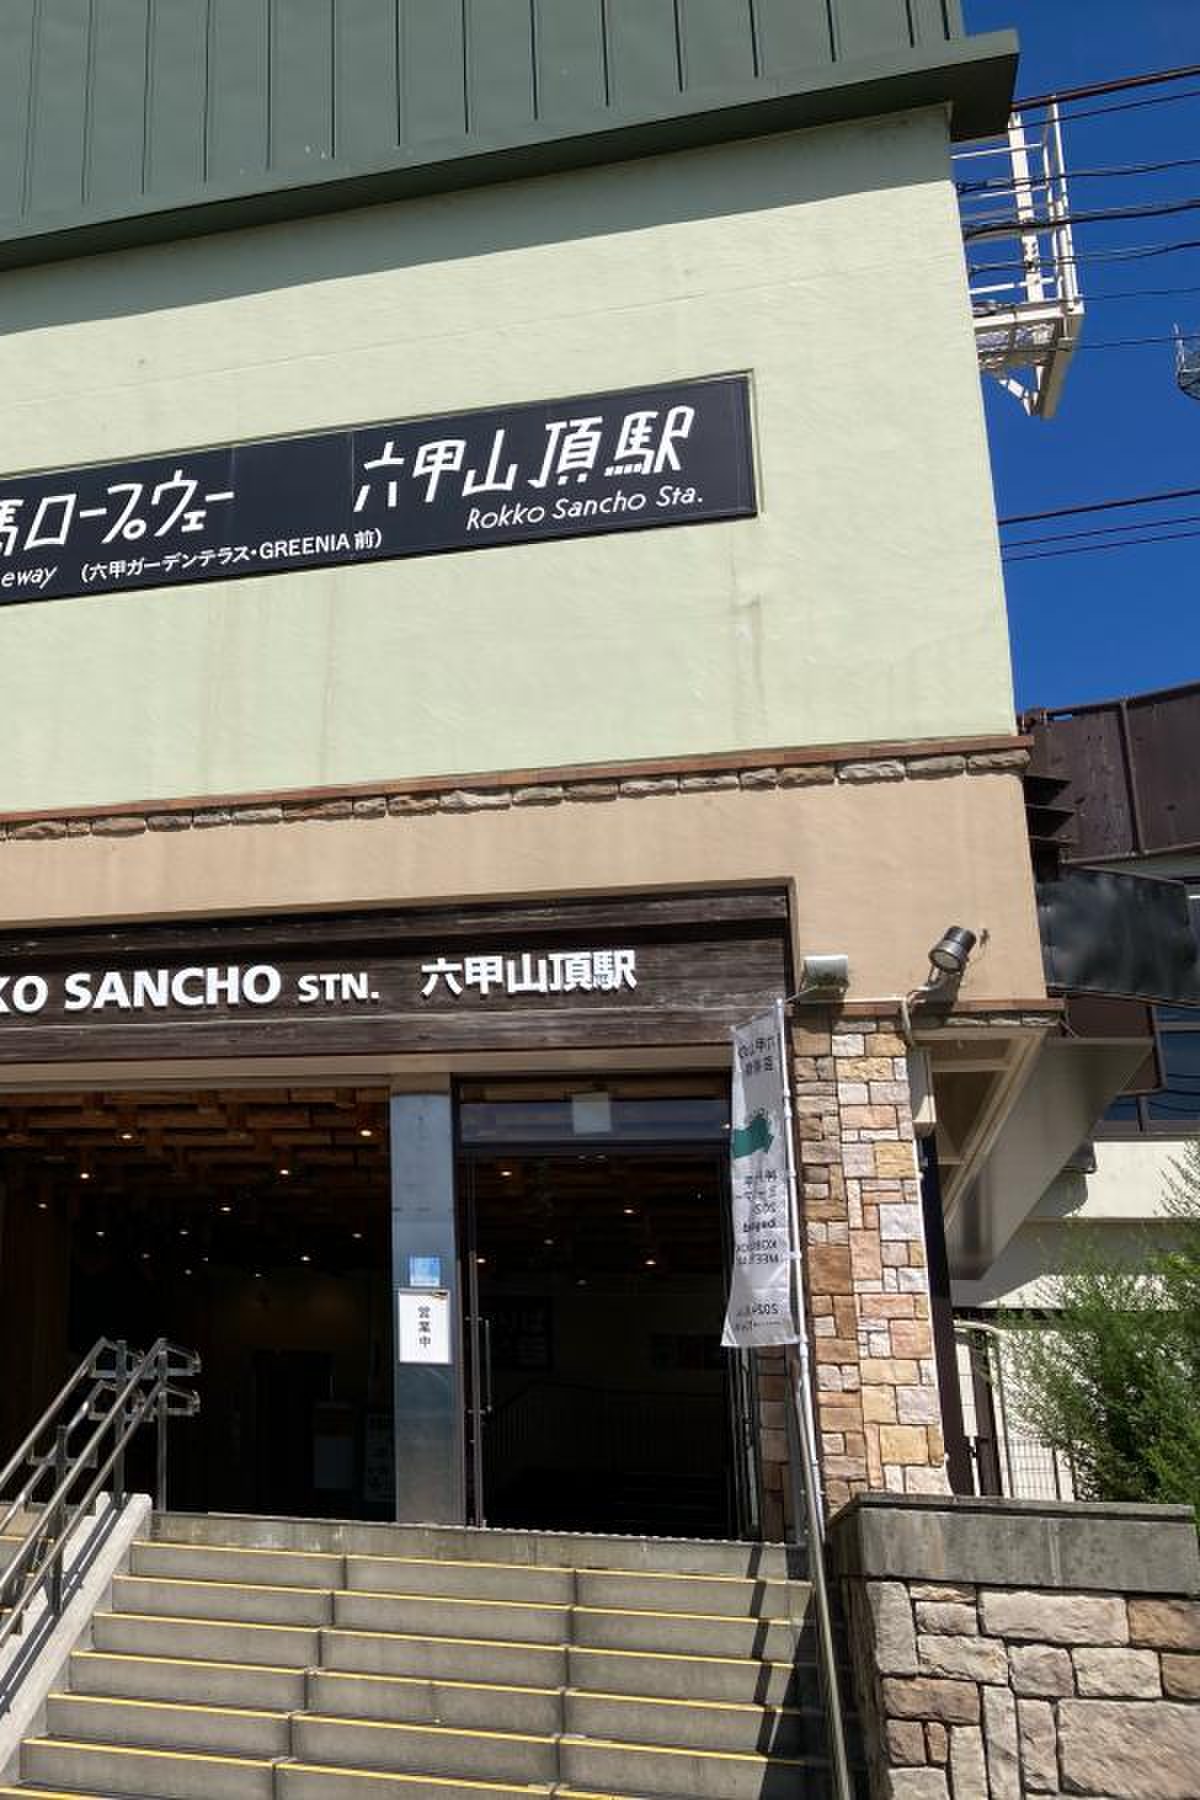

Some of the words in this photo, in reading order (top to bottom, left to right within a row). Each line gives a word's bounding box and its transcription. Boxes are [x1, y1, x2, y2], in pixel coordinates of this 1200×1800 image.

[352, 405, 695, 512] 六甲山頂駅
[466, 503, 545, 530] Rokko
[551, 489, 646, 519] Sancho
[656, 485, 703, 507] Sta.
[64, 964, 282, 1010] SANCHO
[298, 972, 380, 1002] STN.
[421, 950, 637, 998] 六甲山頂駅
